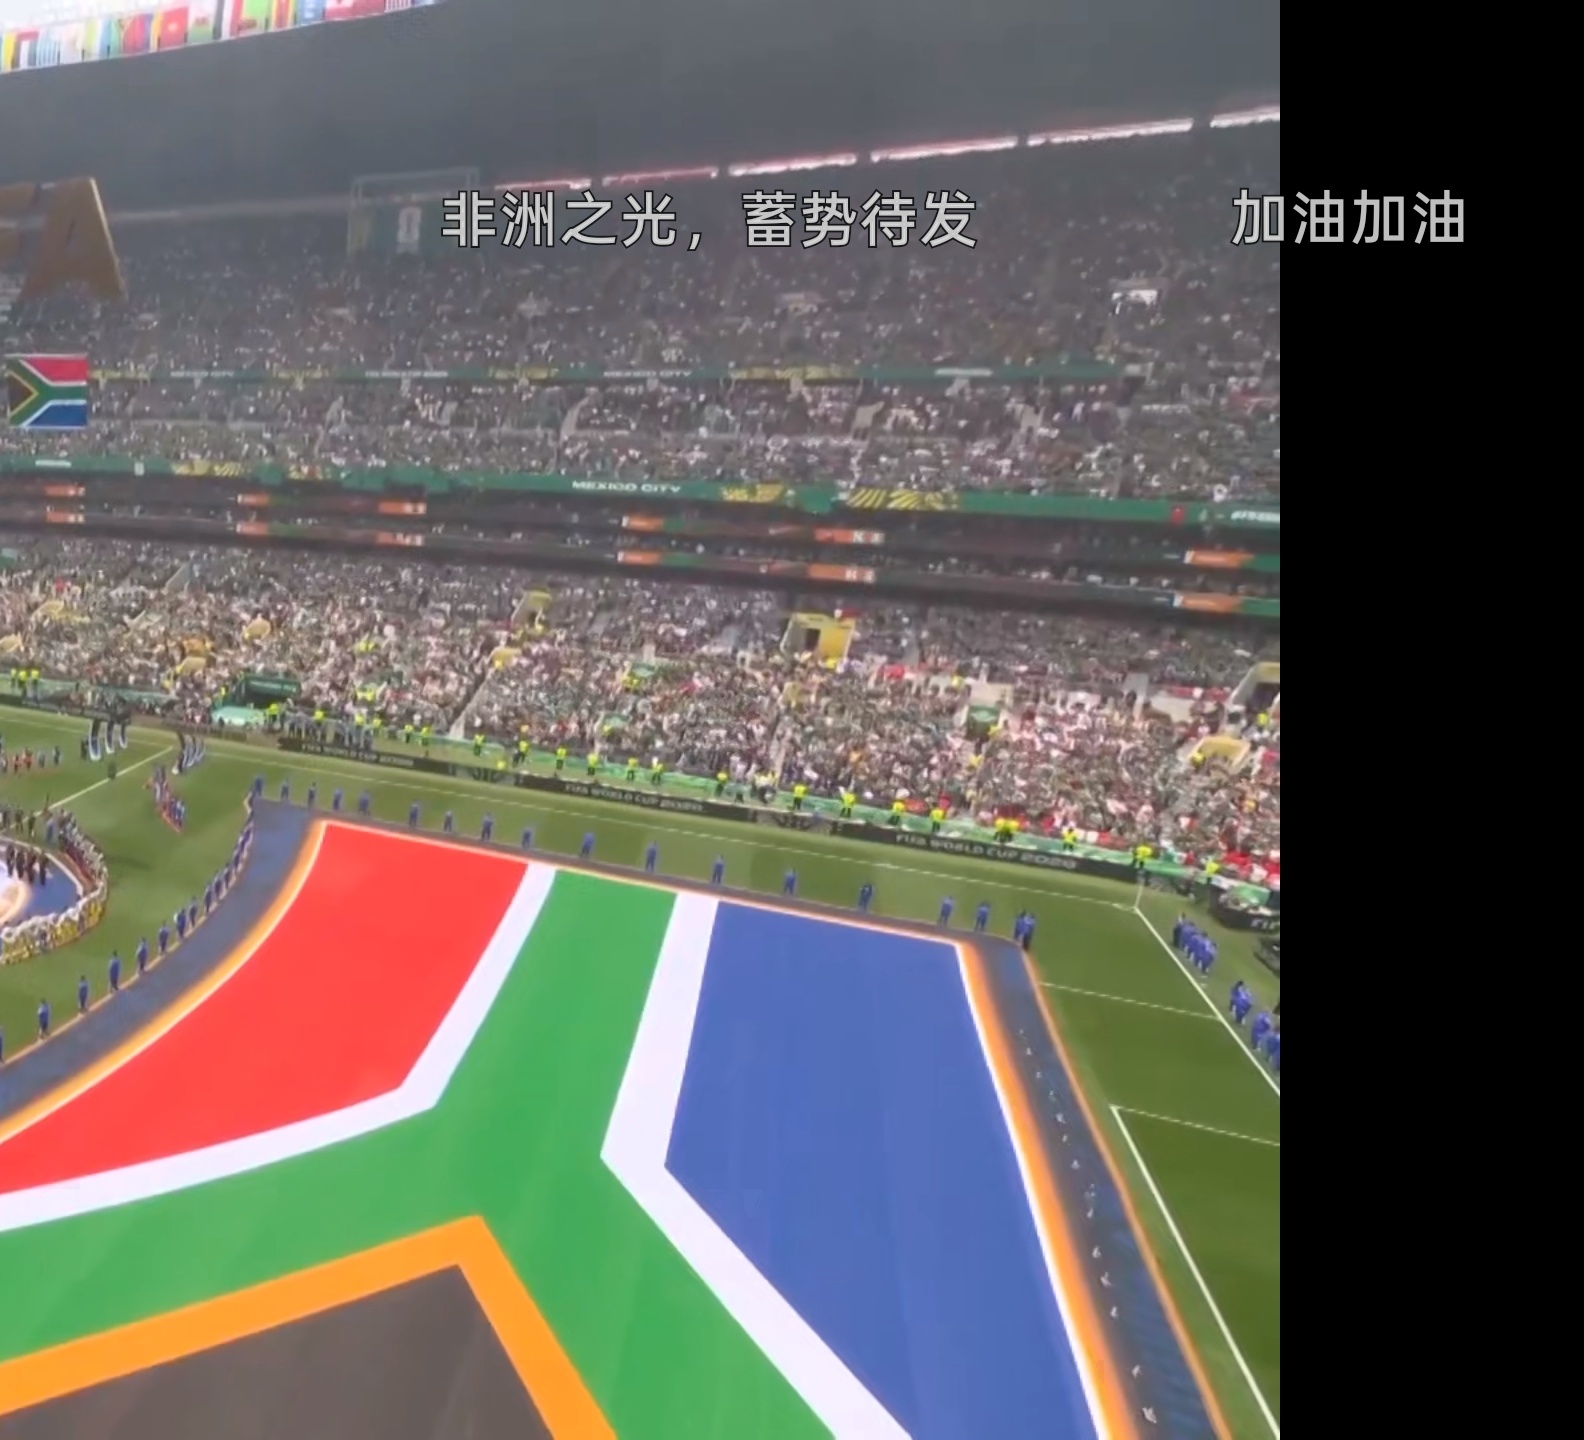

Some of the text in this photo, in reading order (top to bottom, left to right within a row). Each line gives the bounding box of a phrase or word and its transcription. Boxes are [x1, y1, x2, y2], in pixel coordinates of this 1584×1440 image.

[659, 369, 693, 378] CITY
[572, 480, 681, 493] MEXICO CITY
[565, 783, 588, 795] FIFA
[591, 786, 633, 803] WORLD
[635, 792, 659, 805] CUP
[896, 833, 1077, 869] FIFA WORLD CUP 2026
